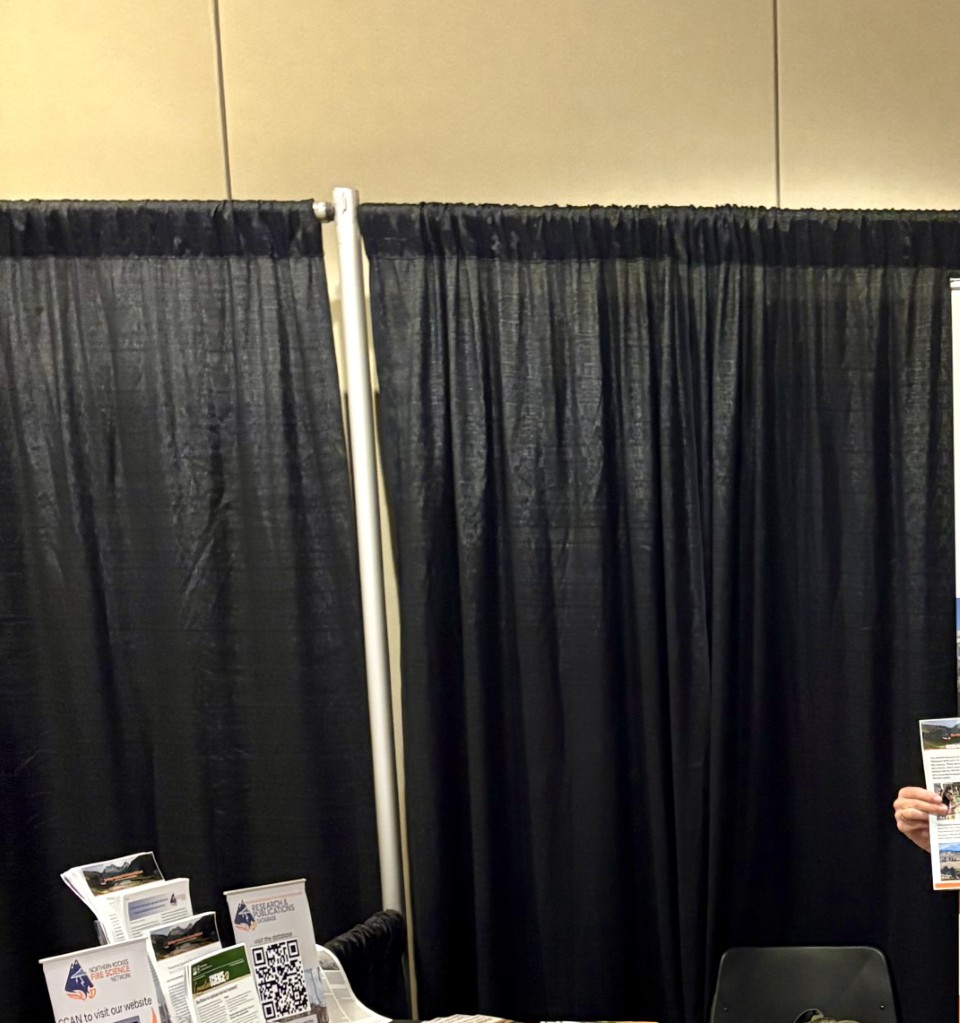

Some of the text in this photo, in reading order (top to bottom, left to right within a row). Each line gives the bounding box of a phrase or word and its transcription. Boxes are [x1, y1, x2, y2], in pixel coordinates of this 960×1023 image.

[89, 963, 112, 973] NORTHERN
[90, 965, 130, 981] FIRE SCIENCE
[111, 973, 131, 982] NETWORK
[83, 1012, 93, 1023] to
[94, 1008, 110, 1020] visit
[111, 1005, 123, 1015] our
[123, 996, 153, 1011] website
